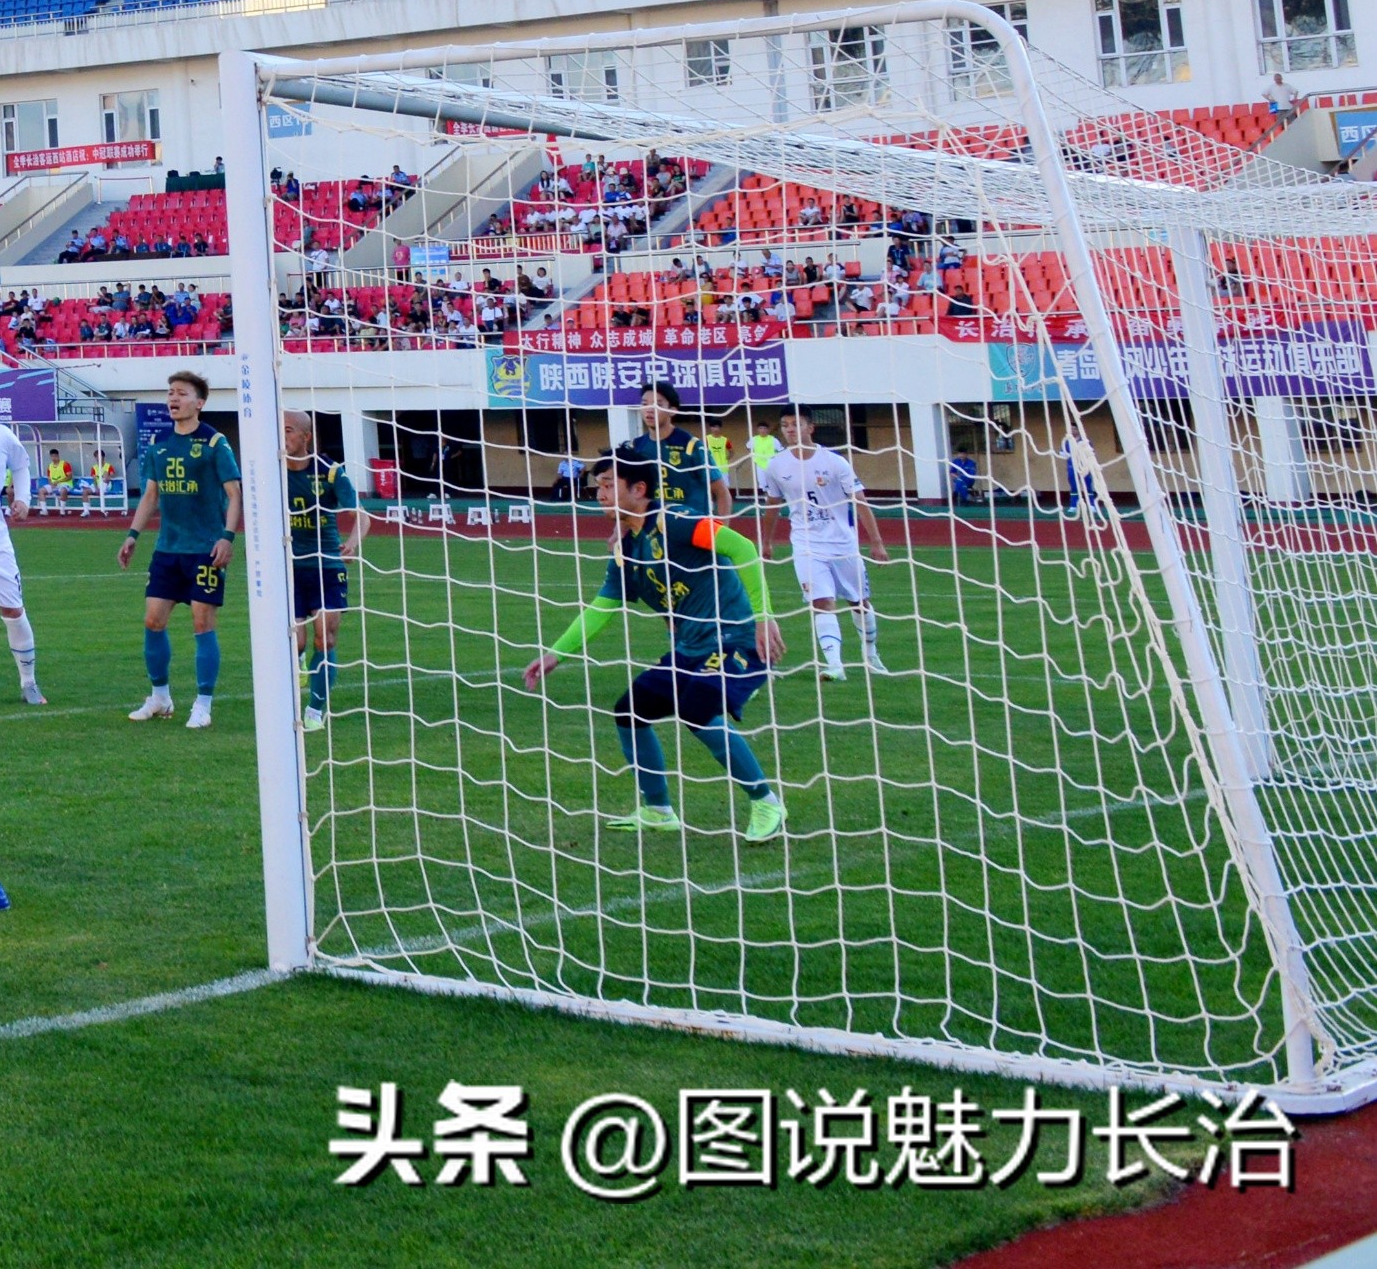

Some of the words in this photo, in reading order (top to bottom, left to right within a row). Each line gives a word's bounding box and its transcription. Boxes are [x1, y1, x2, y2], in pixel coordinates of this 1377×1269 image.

[589, 330, 654, 347] 众志成城
[664, 327, 727, 345] 革命老区
[166, 457, 185, 478] 26
[196, 566, 218, 587] 26
